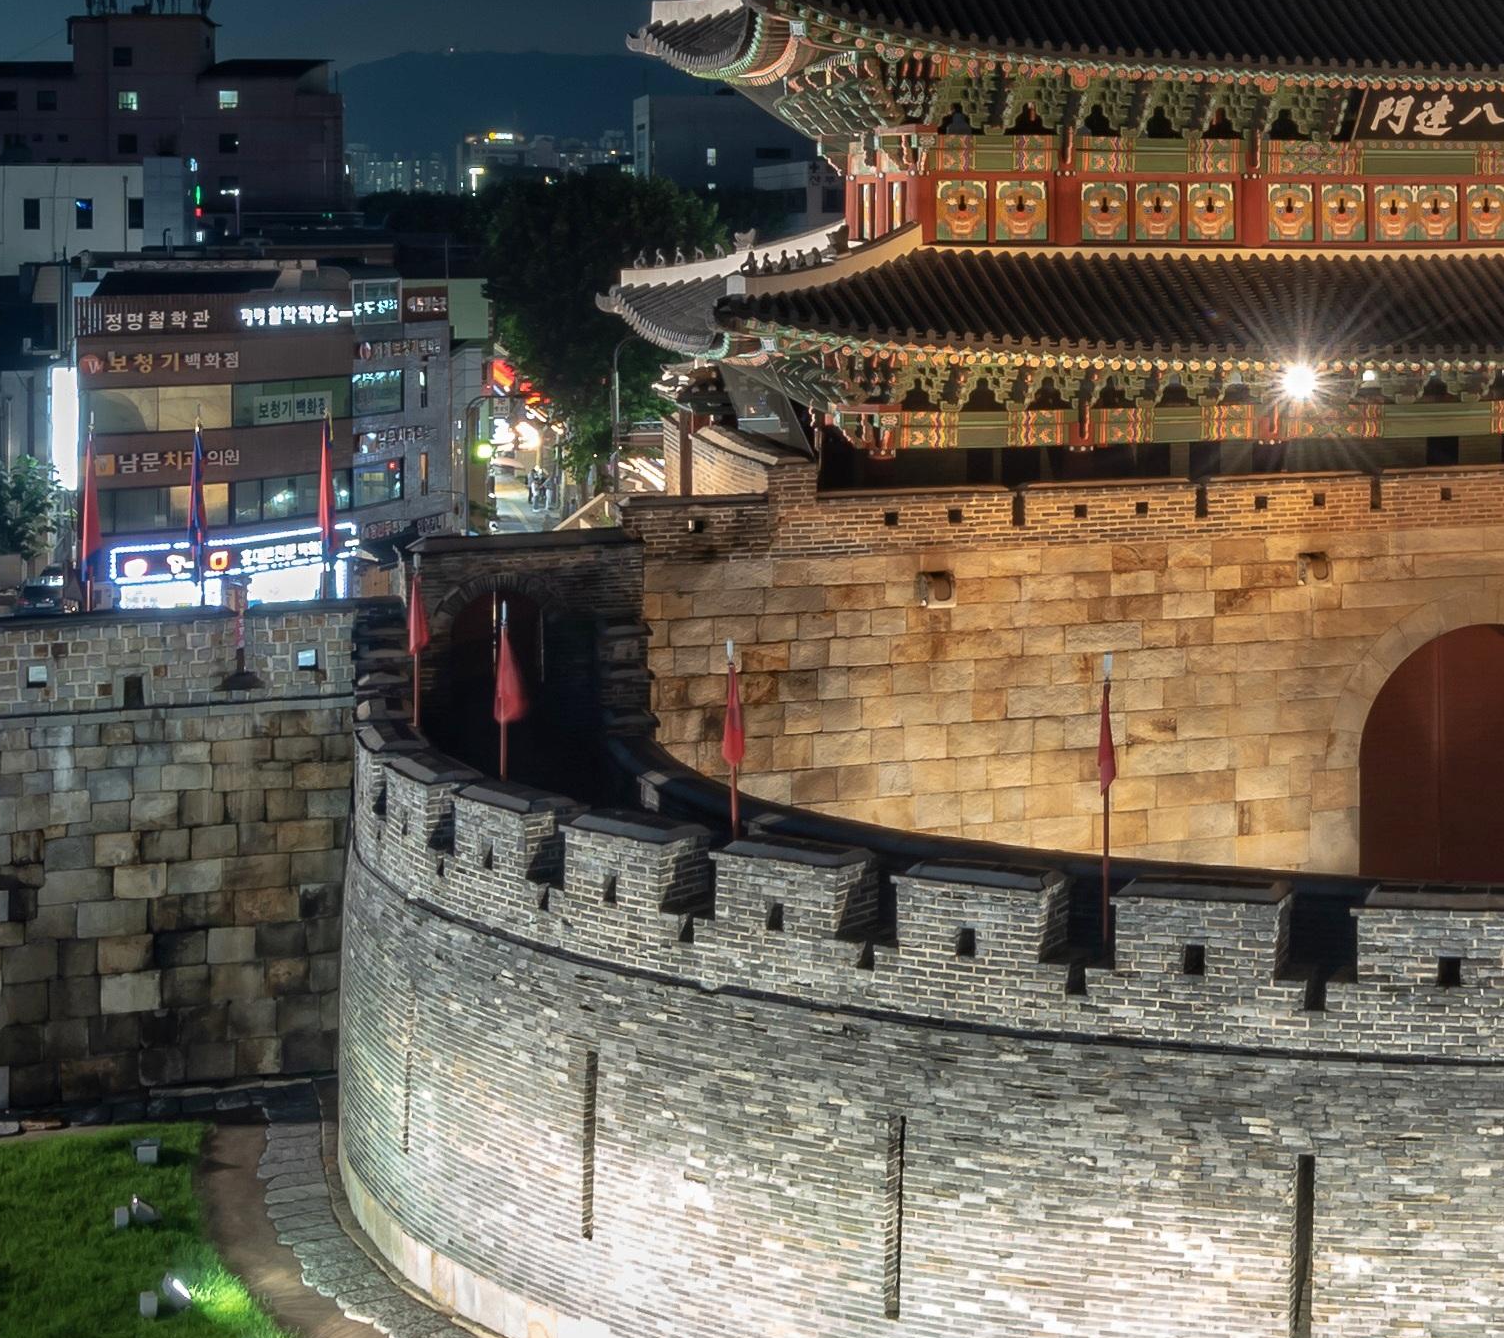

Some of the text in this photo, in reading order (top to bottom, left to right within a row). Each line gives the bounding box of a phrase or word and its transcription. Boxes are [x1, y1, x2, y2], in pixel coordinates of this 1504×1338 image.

[105, 309, 210, 332] 정명철학관
[107, 351, 240, 374] 보청기 백화점
[258, 400, 292, 419] 보청기
[207, 449, 240, 467] 의원
